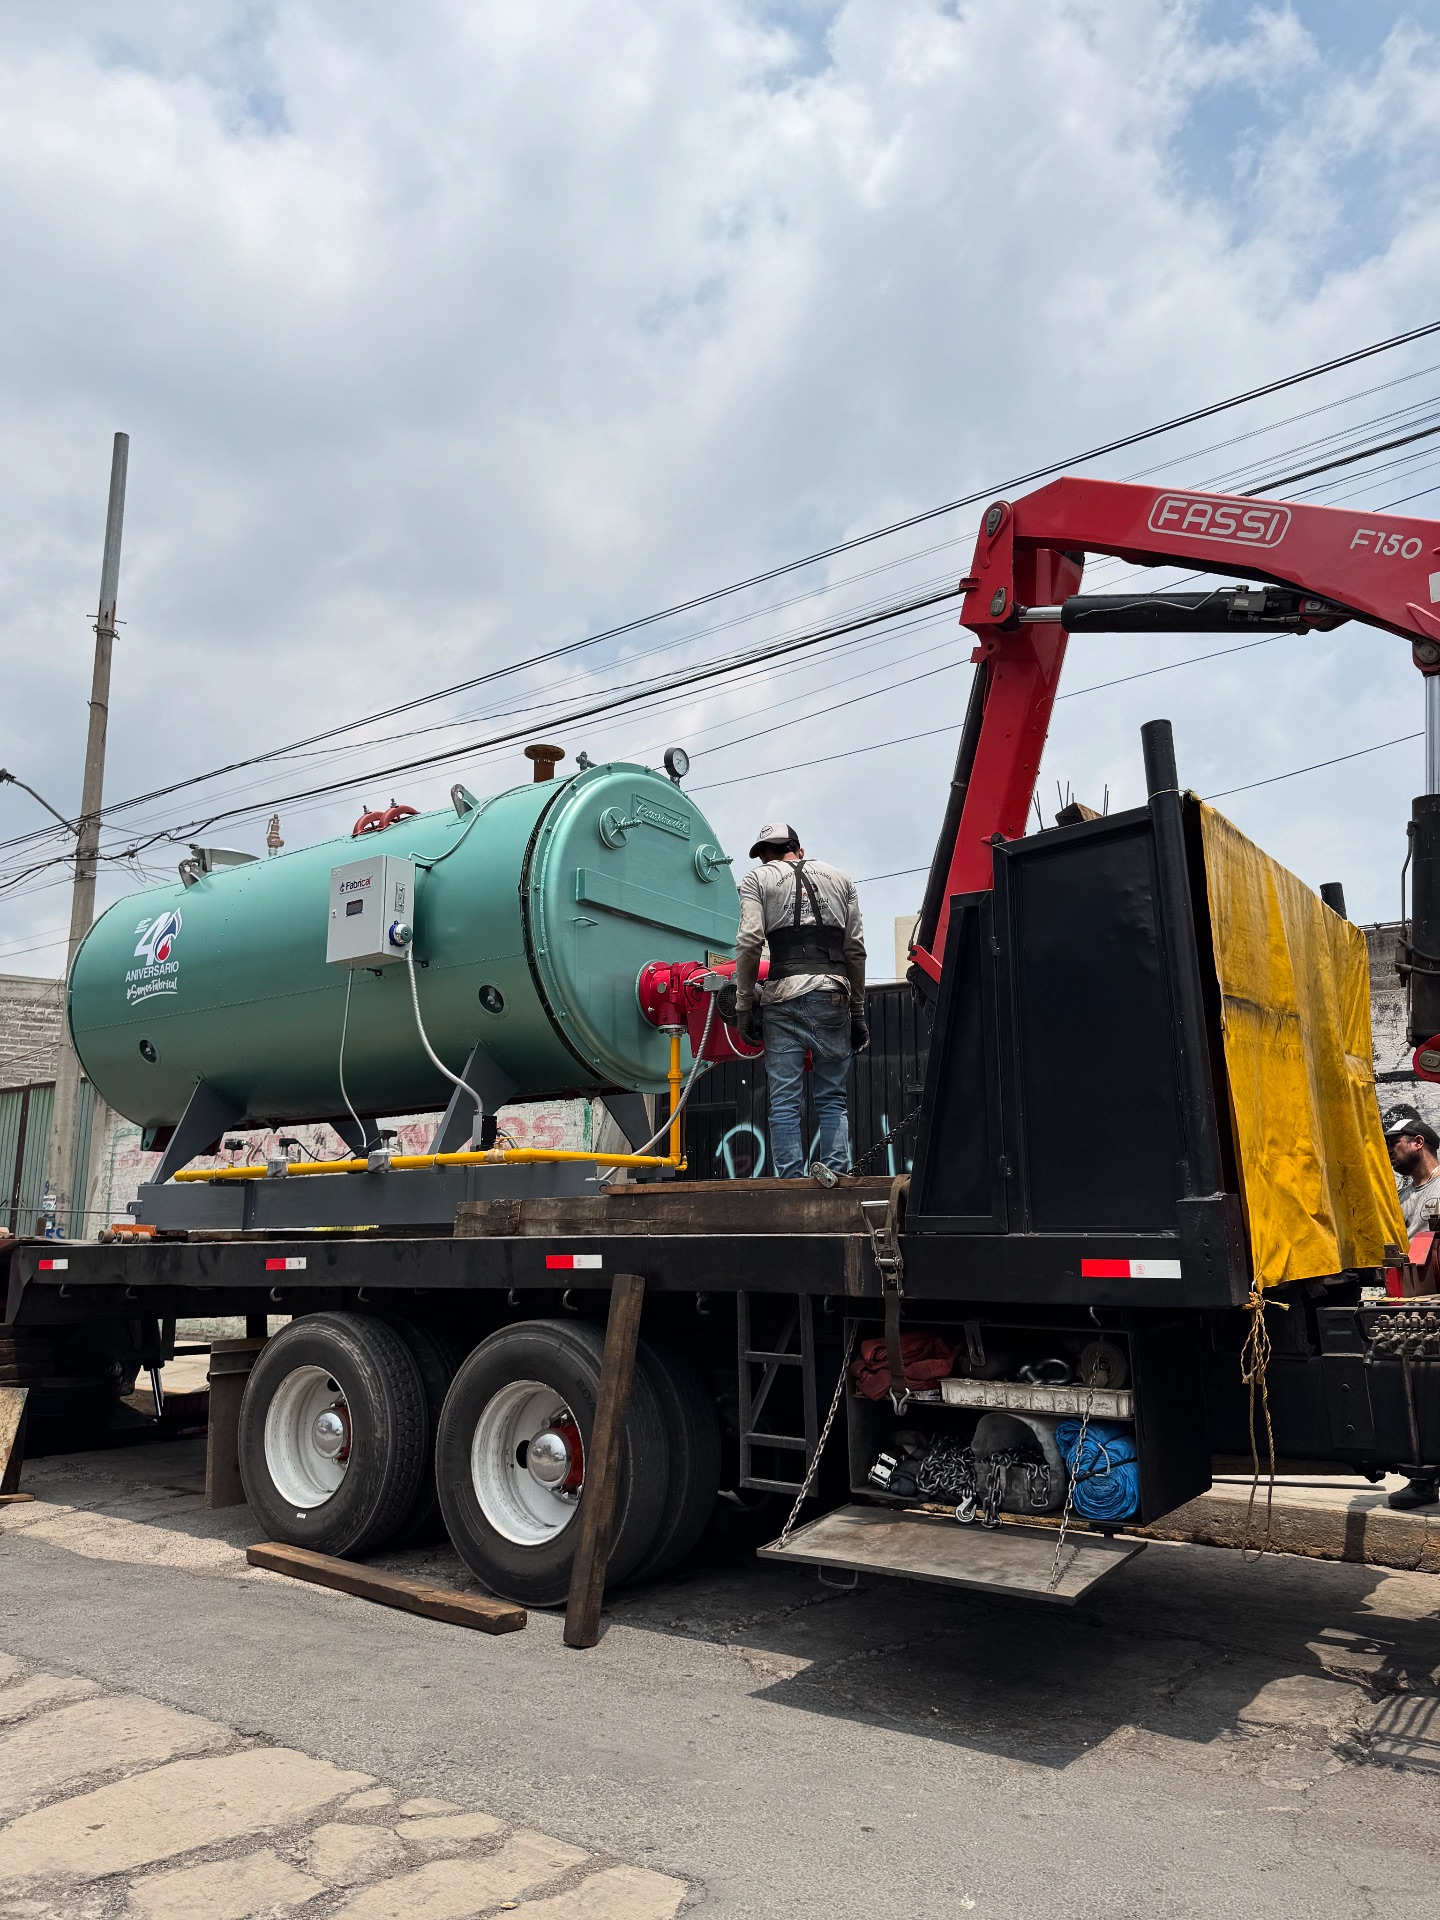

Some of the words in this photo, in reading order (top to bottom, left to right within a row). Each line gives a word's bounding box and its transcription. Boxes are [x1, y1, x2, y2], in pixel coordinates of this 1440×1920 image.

[1157, 499, 1281, 541] FASSI
[1349, 527, 1424, 560] F150
[345, 876, 372, 891] Fabrical
[125, 960, 180, 982] ANIVERSARIO
[126, 976, 178, 1000] #SomosFabrical
